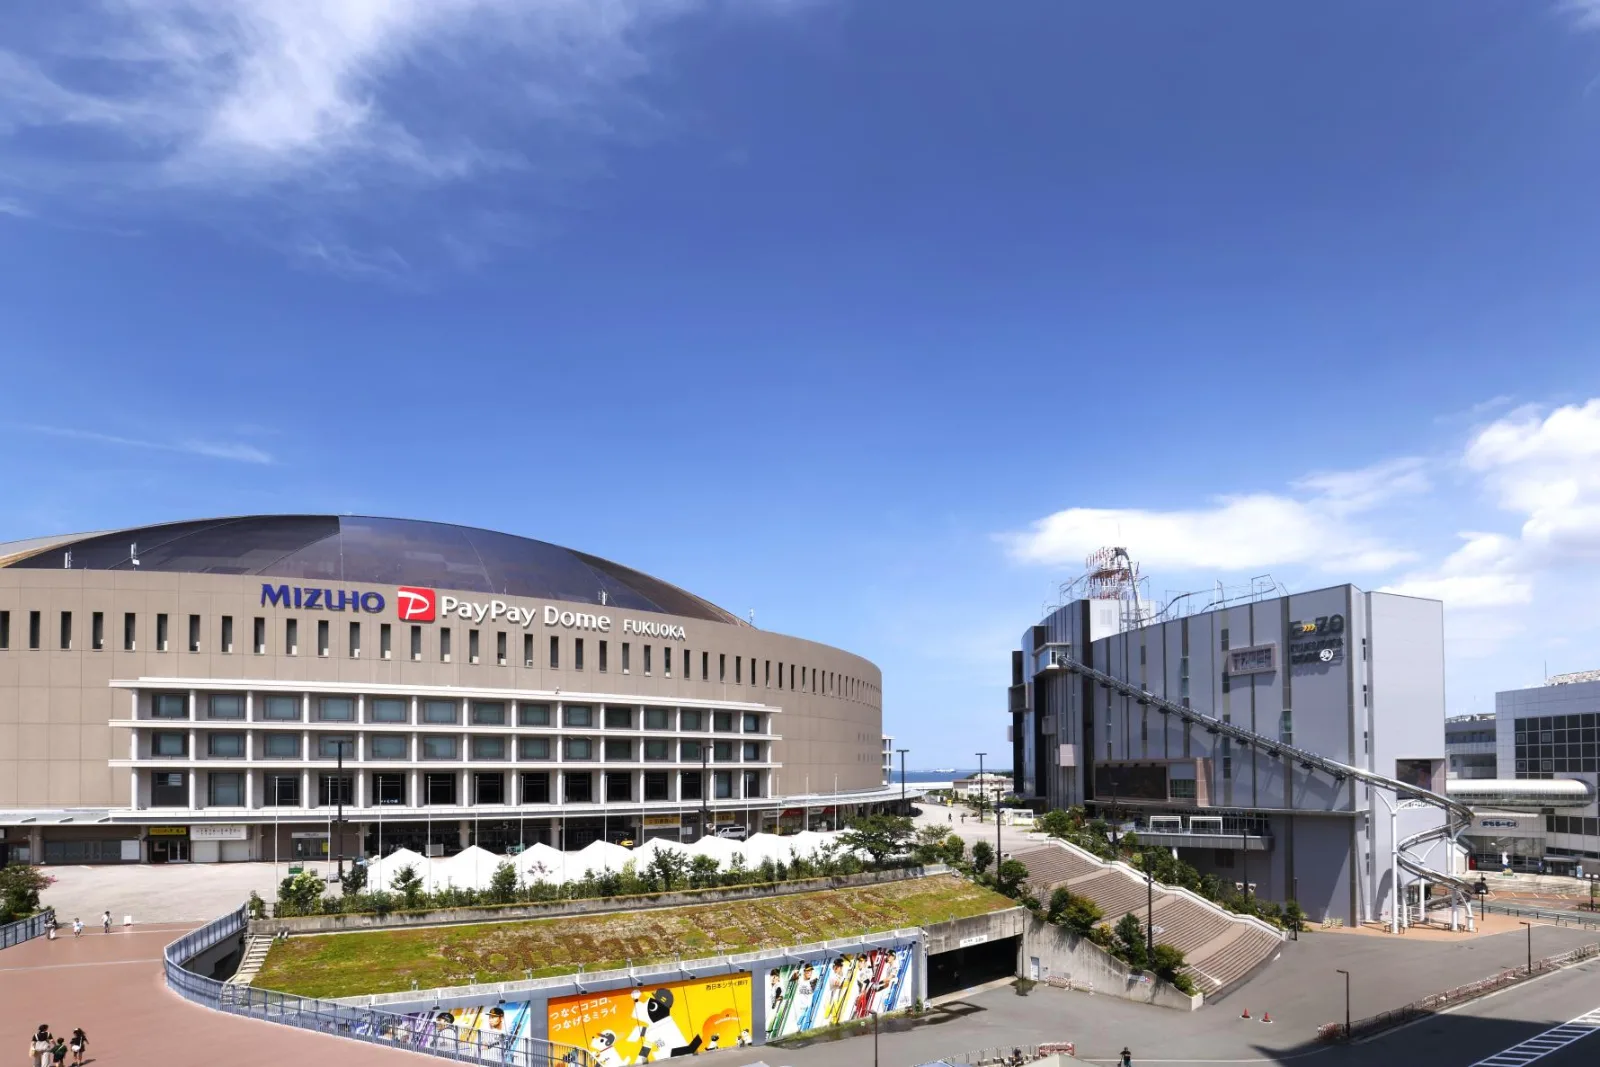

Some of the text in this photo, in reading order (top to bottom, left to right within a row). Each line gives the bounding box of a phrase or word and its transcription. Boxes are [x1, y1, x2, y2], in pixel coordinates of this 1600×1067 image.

[261, 584, 386, 613] MIZUHO
[441, 595, 537, 629] PayPay
[544, 605, 612, 632] Dome
[623, 619, 687, 640] FUKUOKA
[552, 1004, 617, 1032] つなげるミライ
